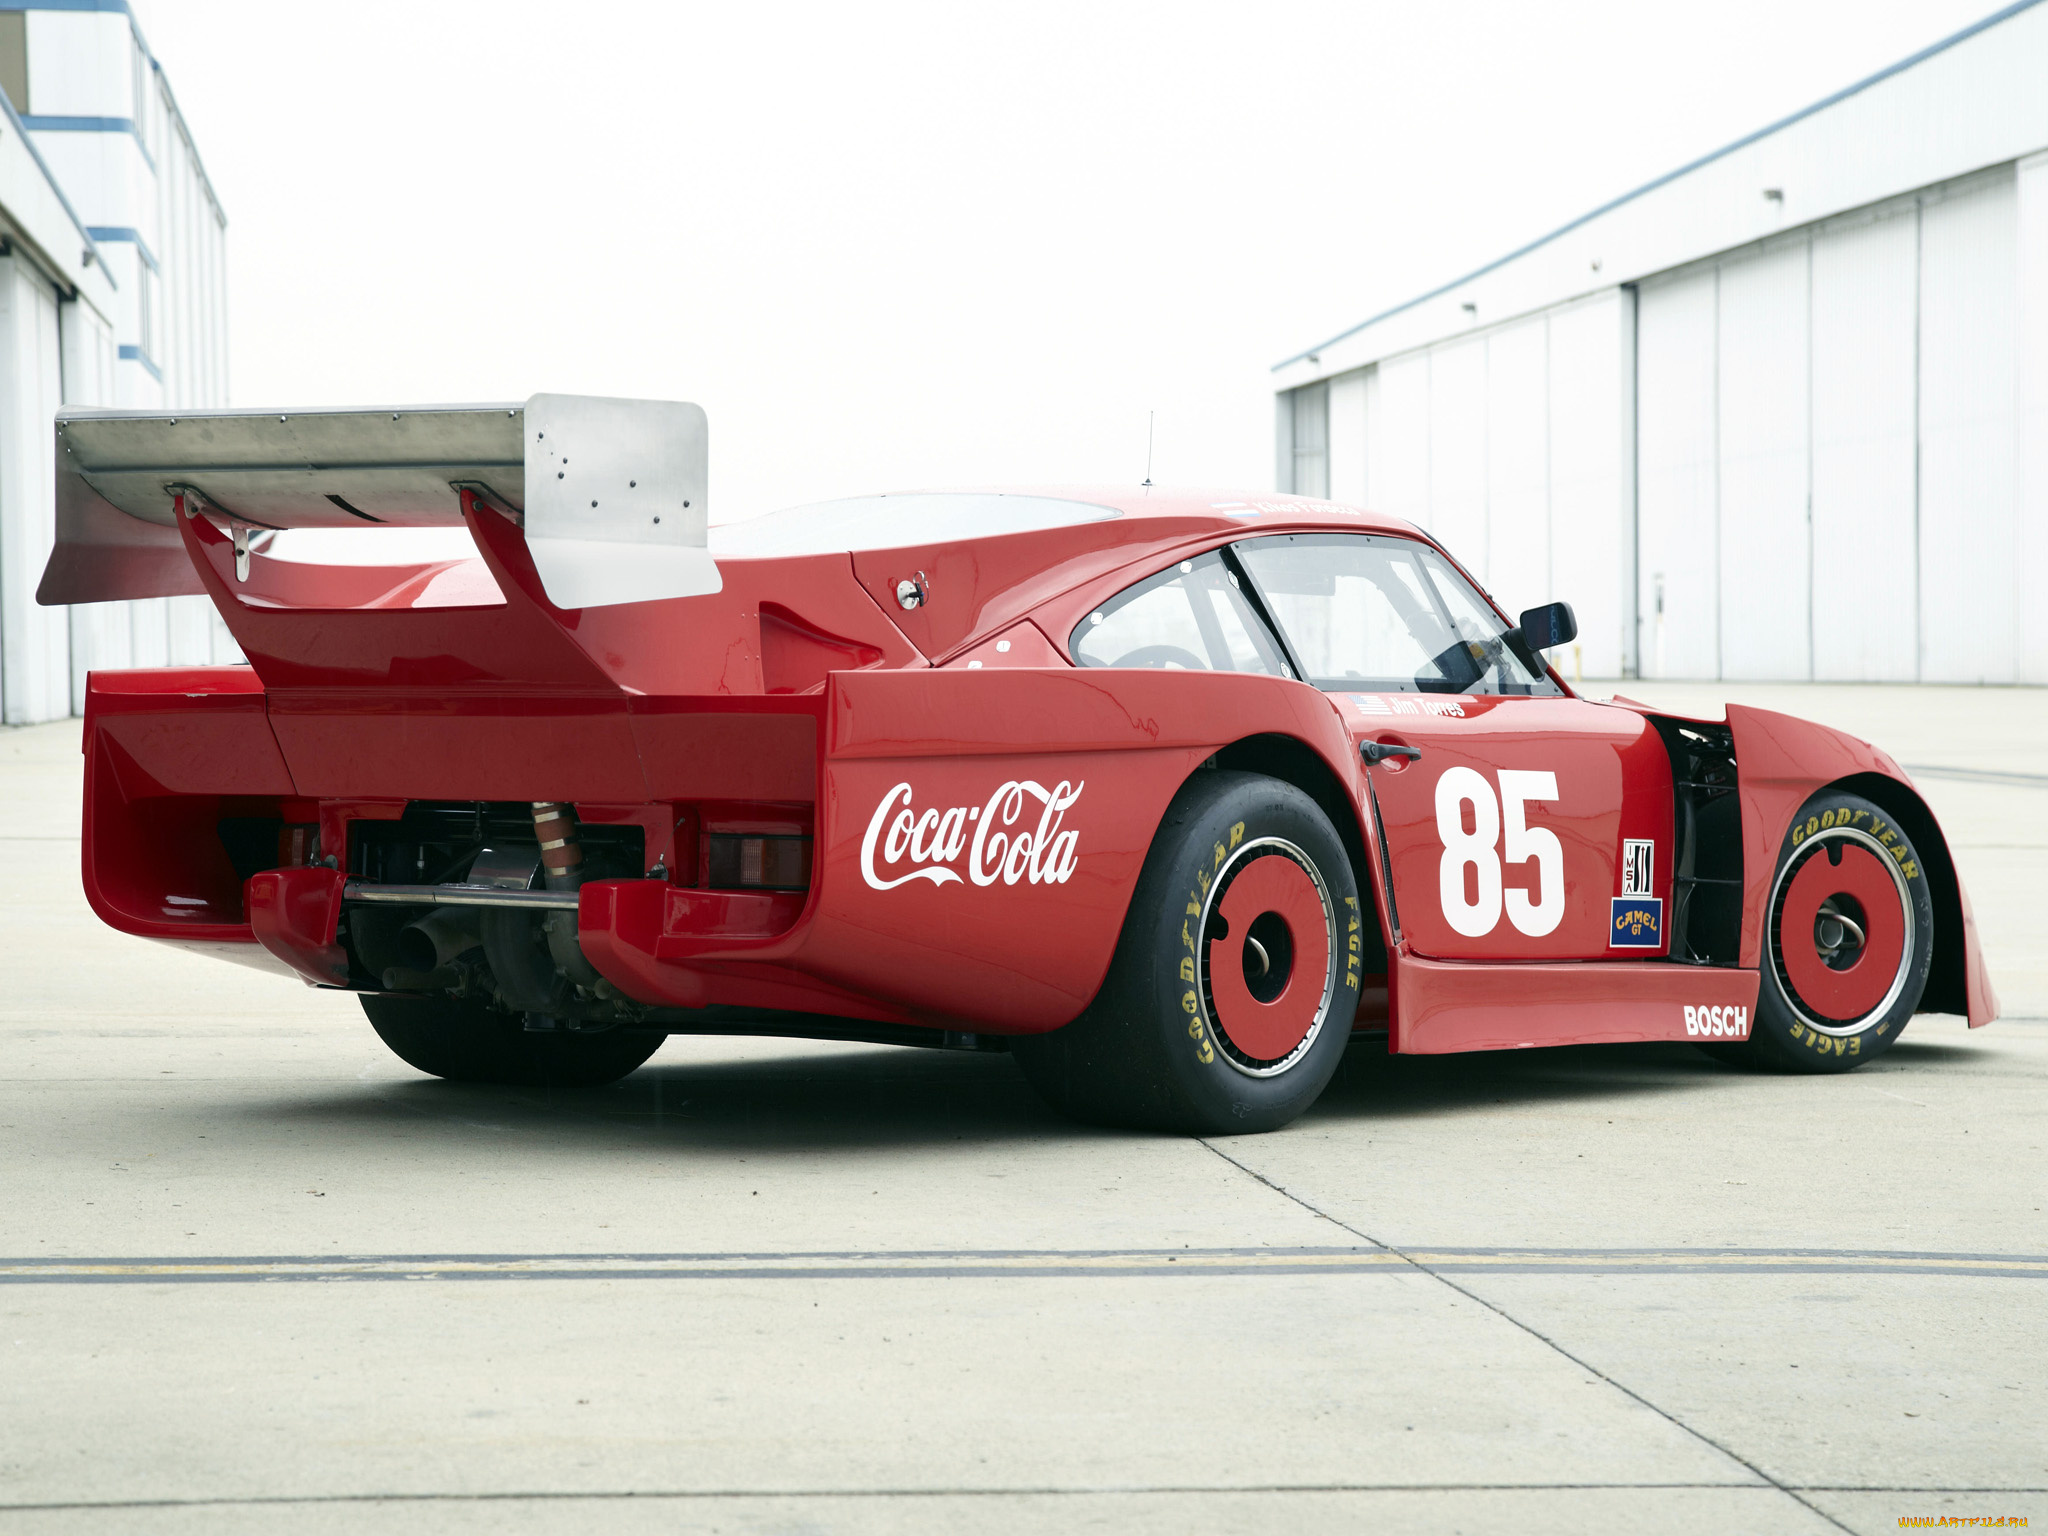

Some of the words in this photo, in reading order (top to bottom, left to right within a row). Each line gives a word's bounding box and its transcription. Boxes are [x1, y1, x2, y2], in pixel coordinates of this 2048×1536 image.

[1389, 697, 1419, 715] Jim
[1413, 698, 1466, 717] Torres
[860, 780, 1085, 891] Coca-Cola
[1435, 766, 1565, 938] 85
[1626, 845, 1634, 893] IMSA
[1616, 910, 1657, 932] CAMEL
[1631, 924, 1642, 936] GT
[1683, 1005, 1747, 1037] BOSCH
[1789, 1019, 1861, 1057] EAGLE
